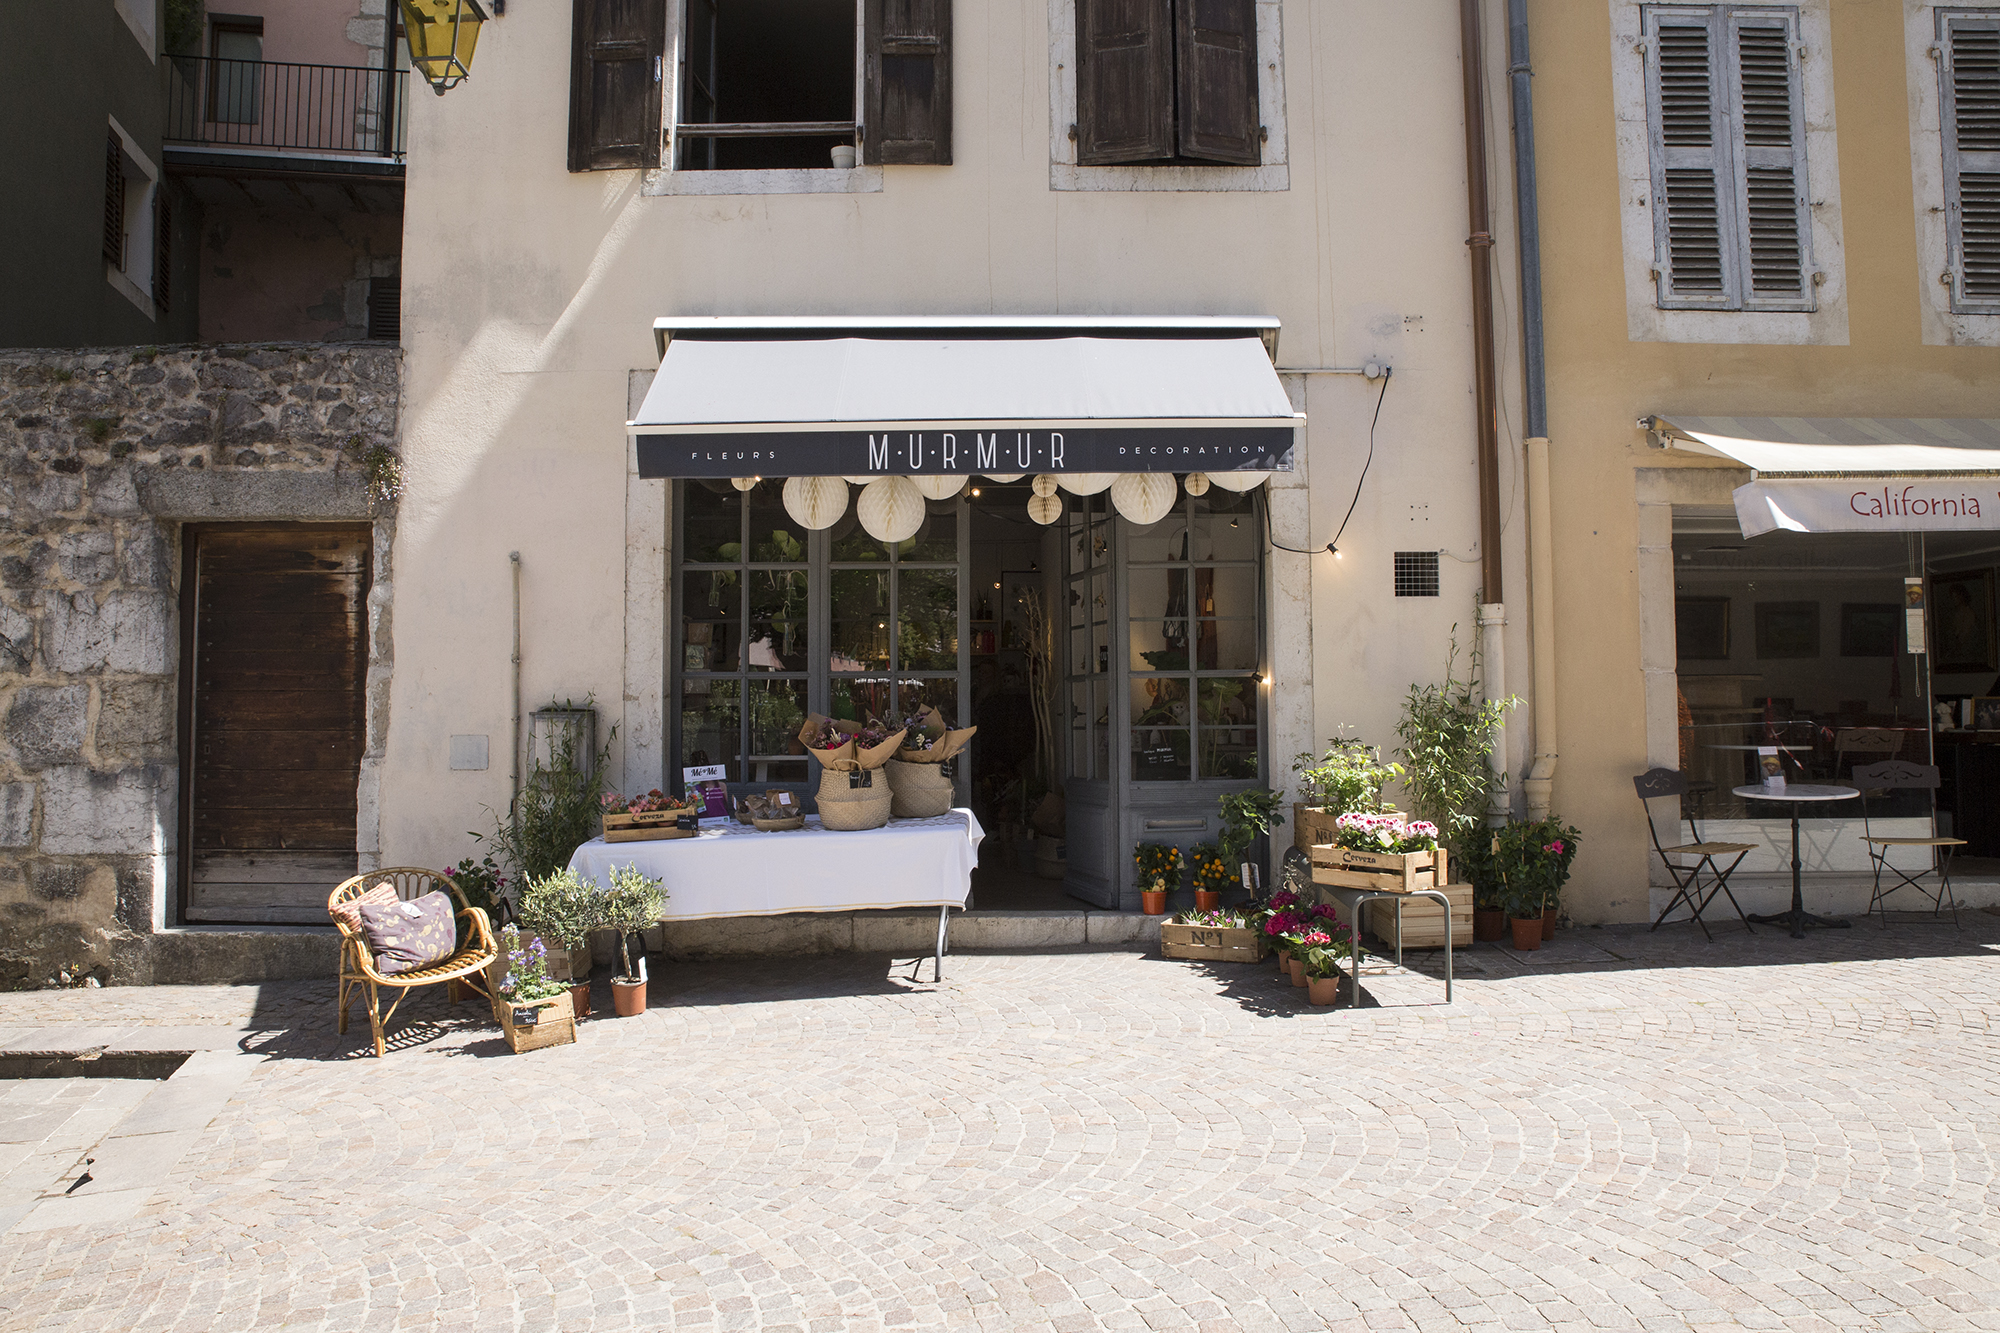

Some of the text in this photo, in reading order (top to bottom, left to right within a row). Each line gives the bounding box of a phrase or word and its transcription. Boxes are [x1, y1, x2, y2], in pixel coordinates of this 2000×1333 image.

[691, 451, 775, 460] FLEURS
[1119, 446, 1265, 455] DECORATION
[1850, 486, 1980, 519] California
[1342, 851, 1377, 864] Cerveza
